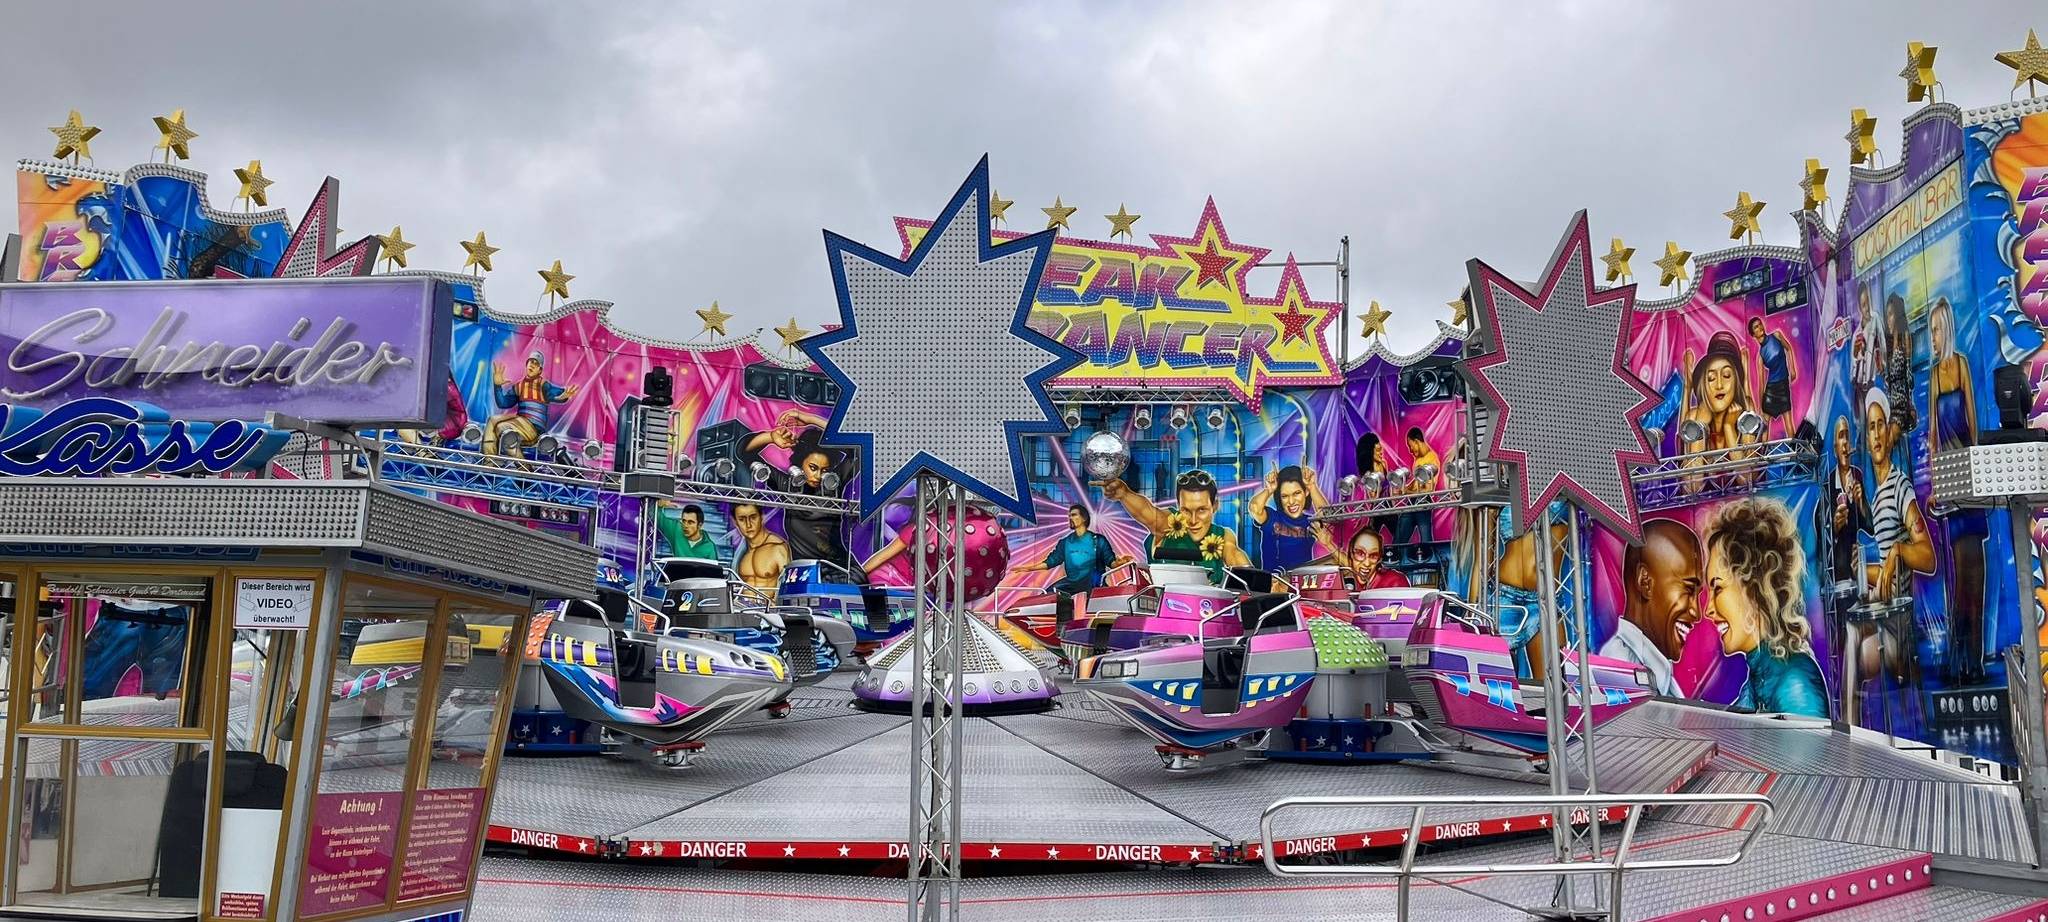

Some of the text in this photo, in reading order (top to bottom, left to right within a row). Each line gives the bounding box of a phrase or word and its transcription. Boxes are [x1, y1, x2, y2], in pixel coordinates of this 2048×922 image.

[1856, 168, 1960, 270] COCKTAIL BAR
[1036, 254, 1231, 314] EAK
[1, 306, 413, 399] Schneider
[241, 582, 311, 591] Dieser Bereich wird
[1301, 574, 1318, 589] 11
[257, 598, 293, 609] VIDEO
[679, 591, 694, 612] 2
[1200, 599, 1214, 619] 8
[253, 614, 295, 623] überwacht!
[1387, 600, 1404, 621] 7
[340, 799, 376, 816] Achtung
[511, 829, 559, 849] DANGER
[1435, 822, 1481, 839] DANGER
[680, 842, 748, 858] DANGER
[1095, 845, 1161, 862] DANGER
[1286, 837, 1336, 855] DANGER
